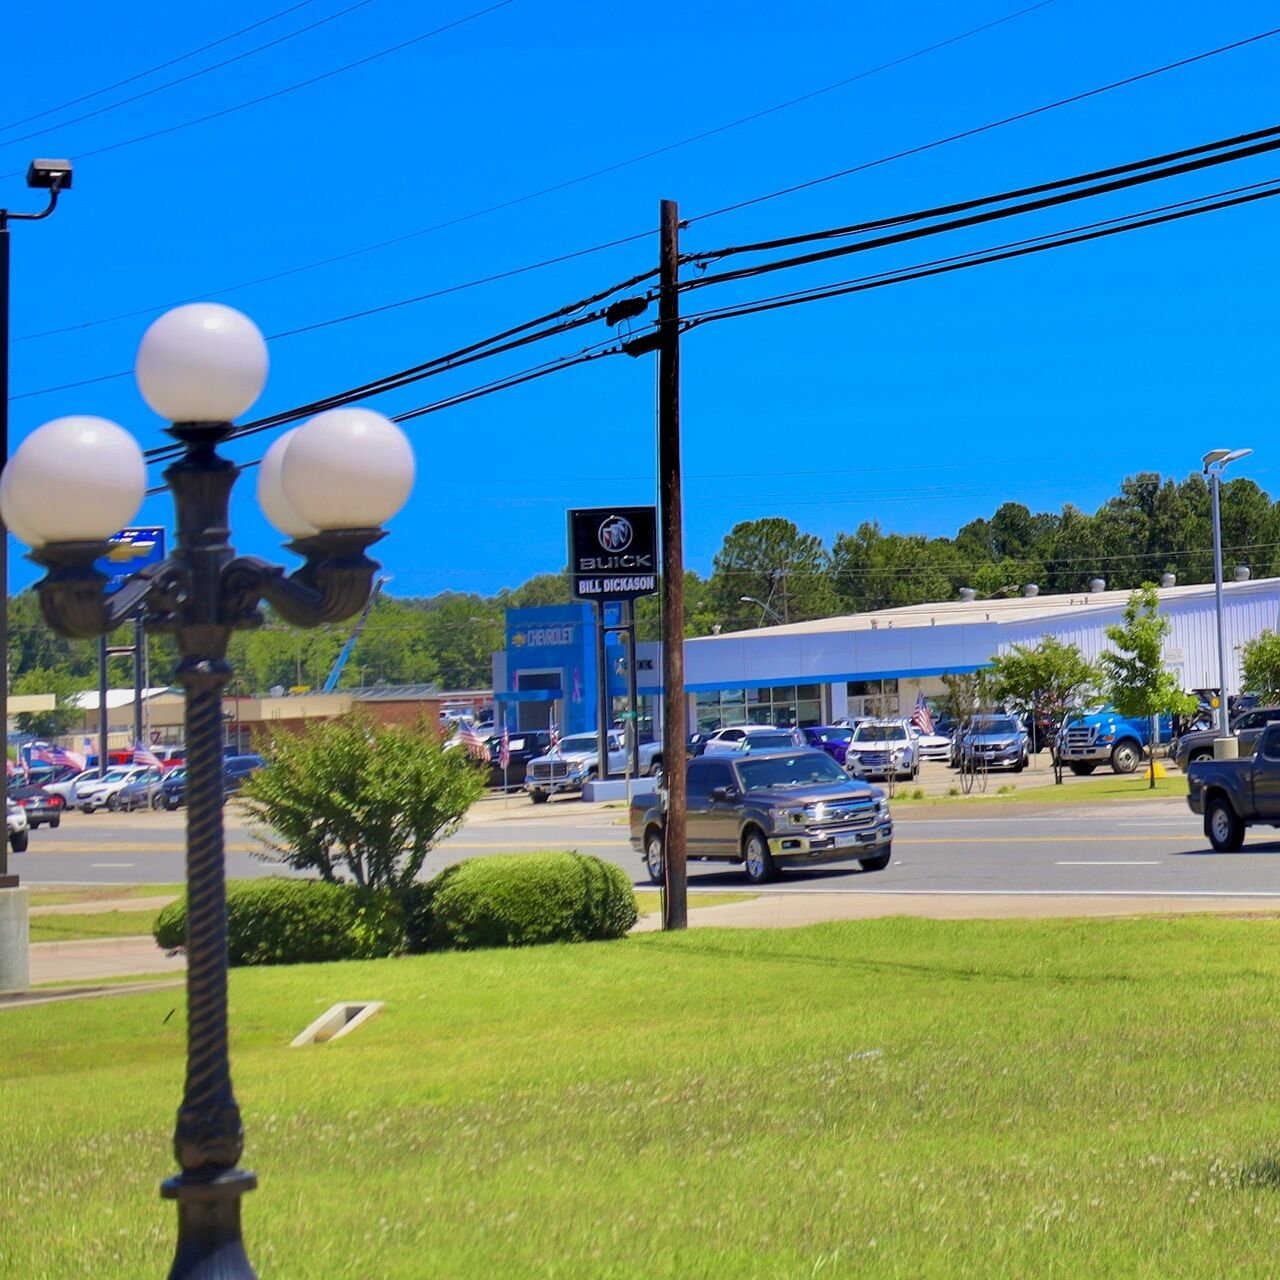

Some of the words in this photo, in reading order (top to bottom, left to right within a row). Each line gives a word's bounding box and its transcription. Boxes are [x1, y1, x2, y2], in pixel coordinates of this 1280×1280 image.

[579, 554, 652, 571] BUICK
[579, 579, 602, 594] BILL
[603, 576, 654, 593] DICKASON
[527, 627, 574, 648] CHEVROLET
